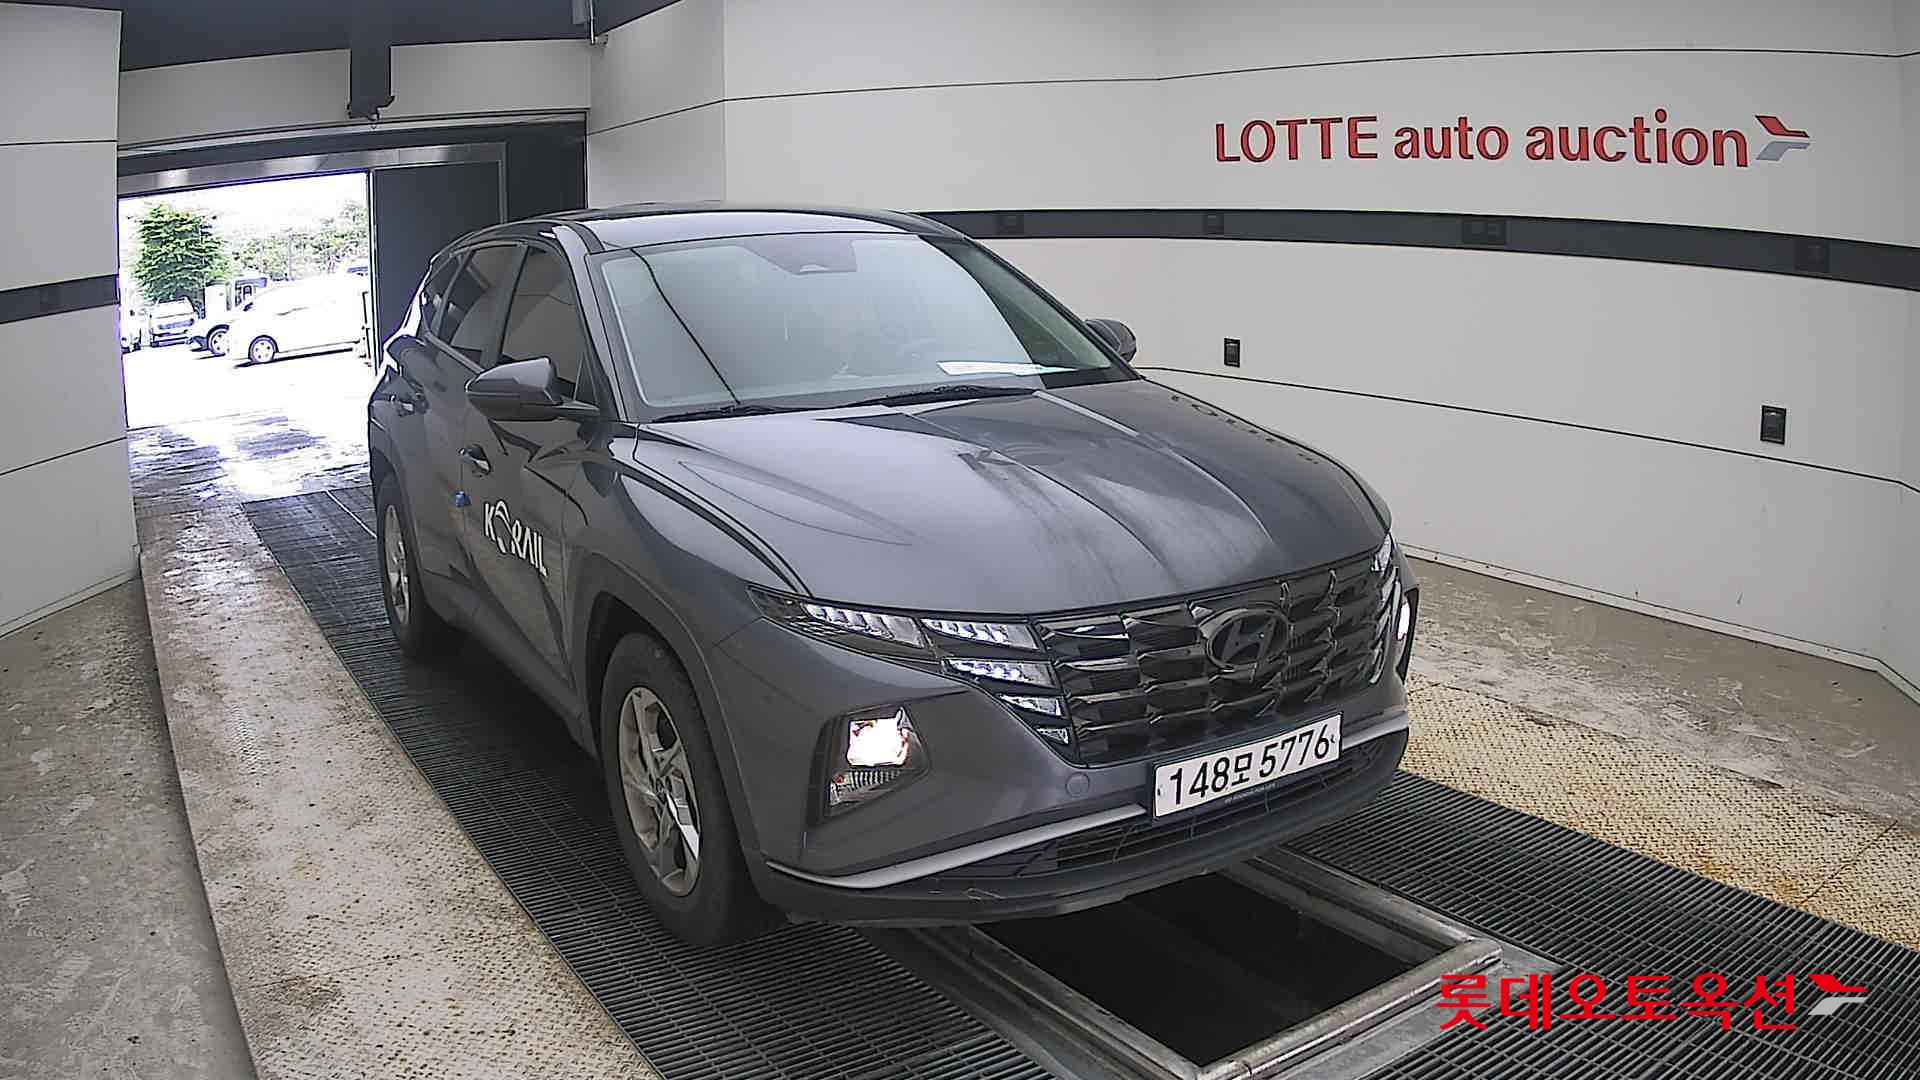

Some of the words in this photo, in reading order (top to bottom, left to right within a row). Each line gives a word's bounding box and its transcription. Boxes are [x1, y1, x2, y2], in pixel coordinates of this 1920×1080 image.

[1215, 116, 1379, 163] LOTTE
[1394, 115, 1510, 161] auto
[1525, 109, 1749, 168] auction
[485, 501, 548, 576] KORAIL
[1259, 724, 1330, 777] 5776
